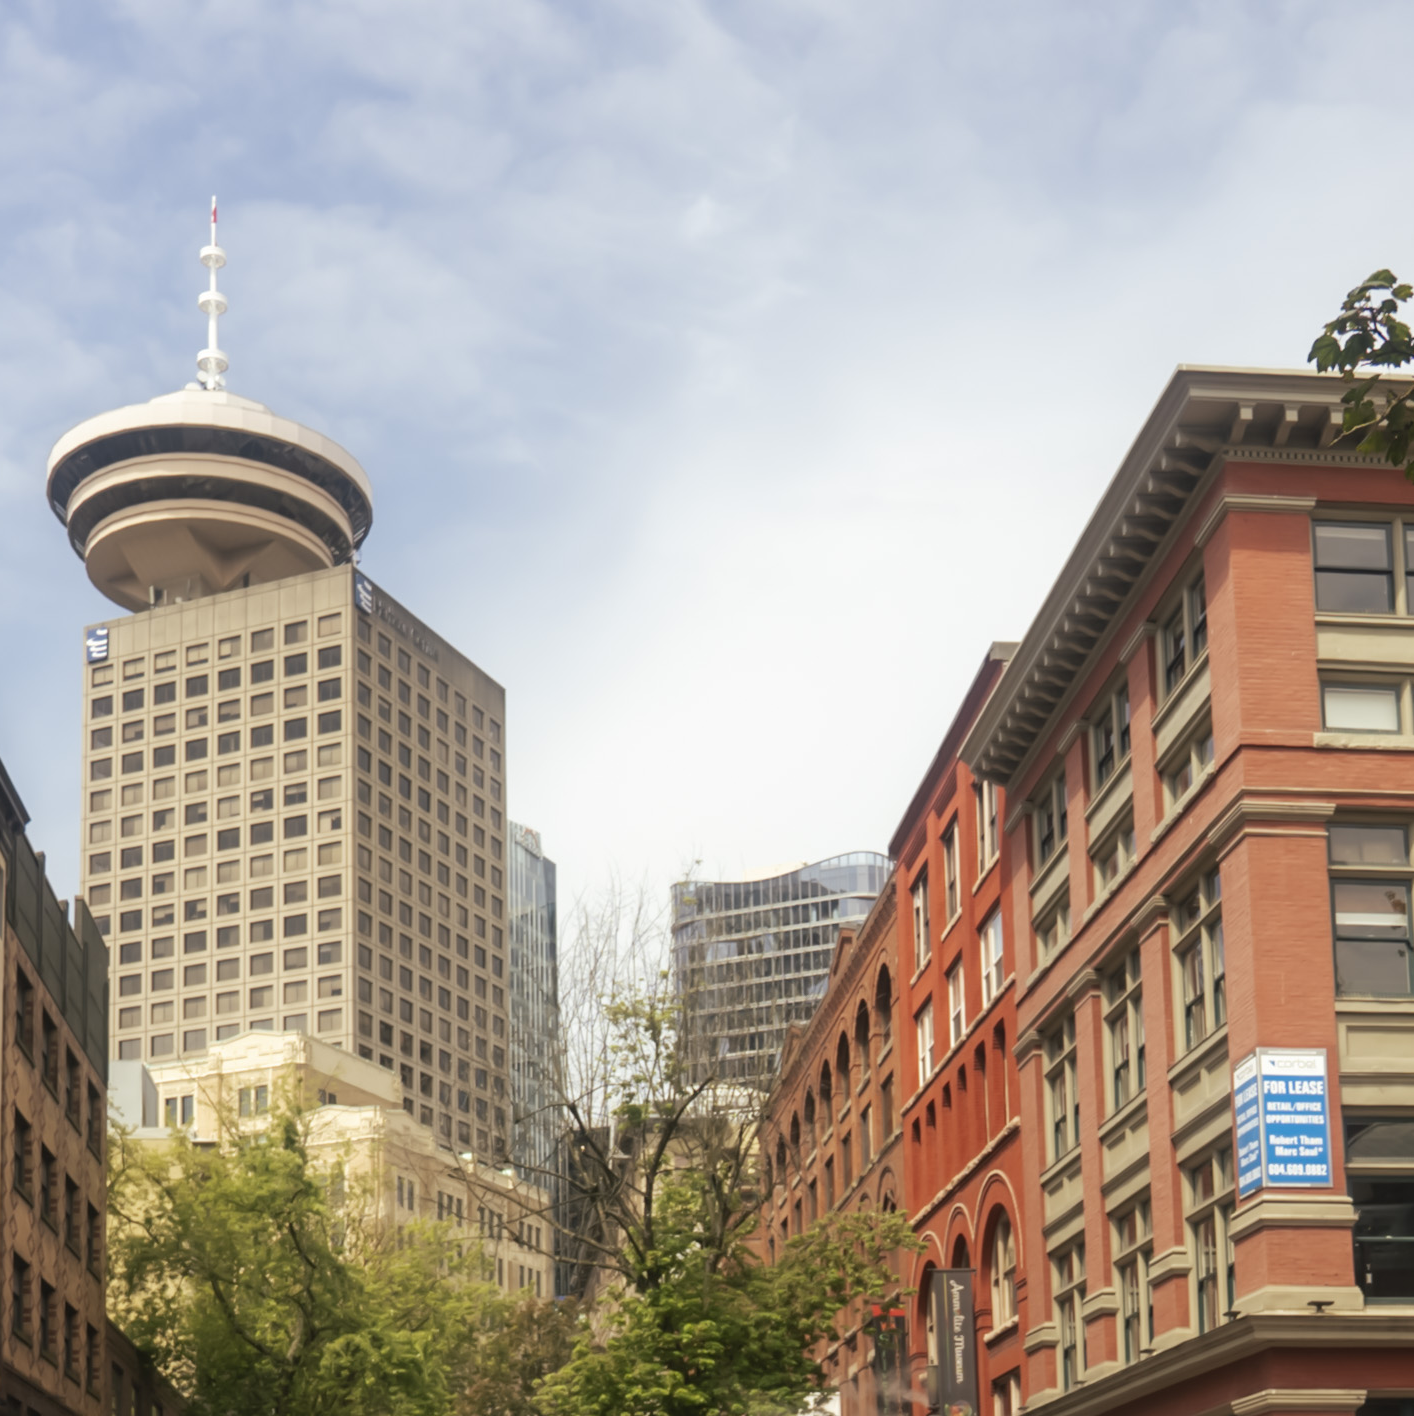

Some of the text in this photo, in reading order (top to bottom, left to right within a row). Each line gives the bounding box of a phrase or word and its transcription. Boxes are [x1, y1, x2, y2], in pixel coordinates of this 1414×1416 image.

[1263, 1080, 1324, 1095] FOR LEASE
[1266, 1101, 1322, 1112] RETAIL/OFFICE
[1265, 1114, 1325, 1125] OPPORTUNITIES
[1269, 1134, 1323, 1146] Robert Tham
[1274, 1145, 1298, 1157] Marc
[953, 1333, 966, 1385] Museum
